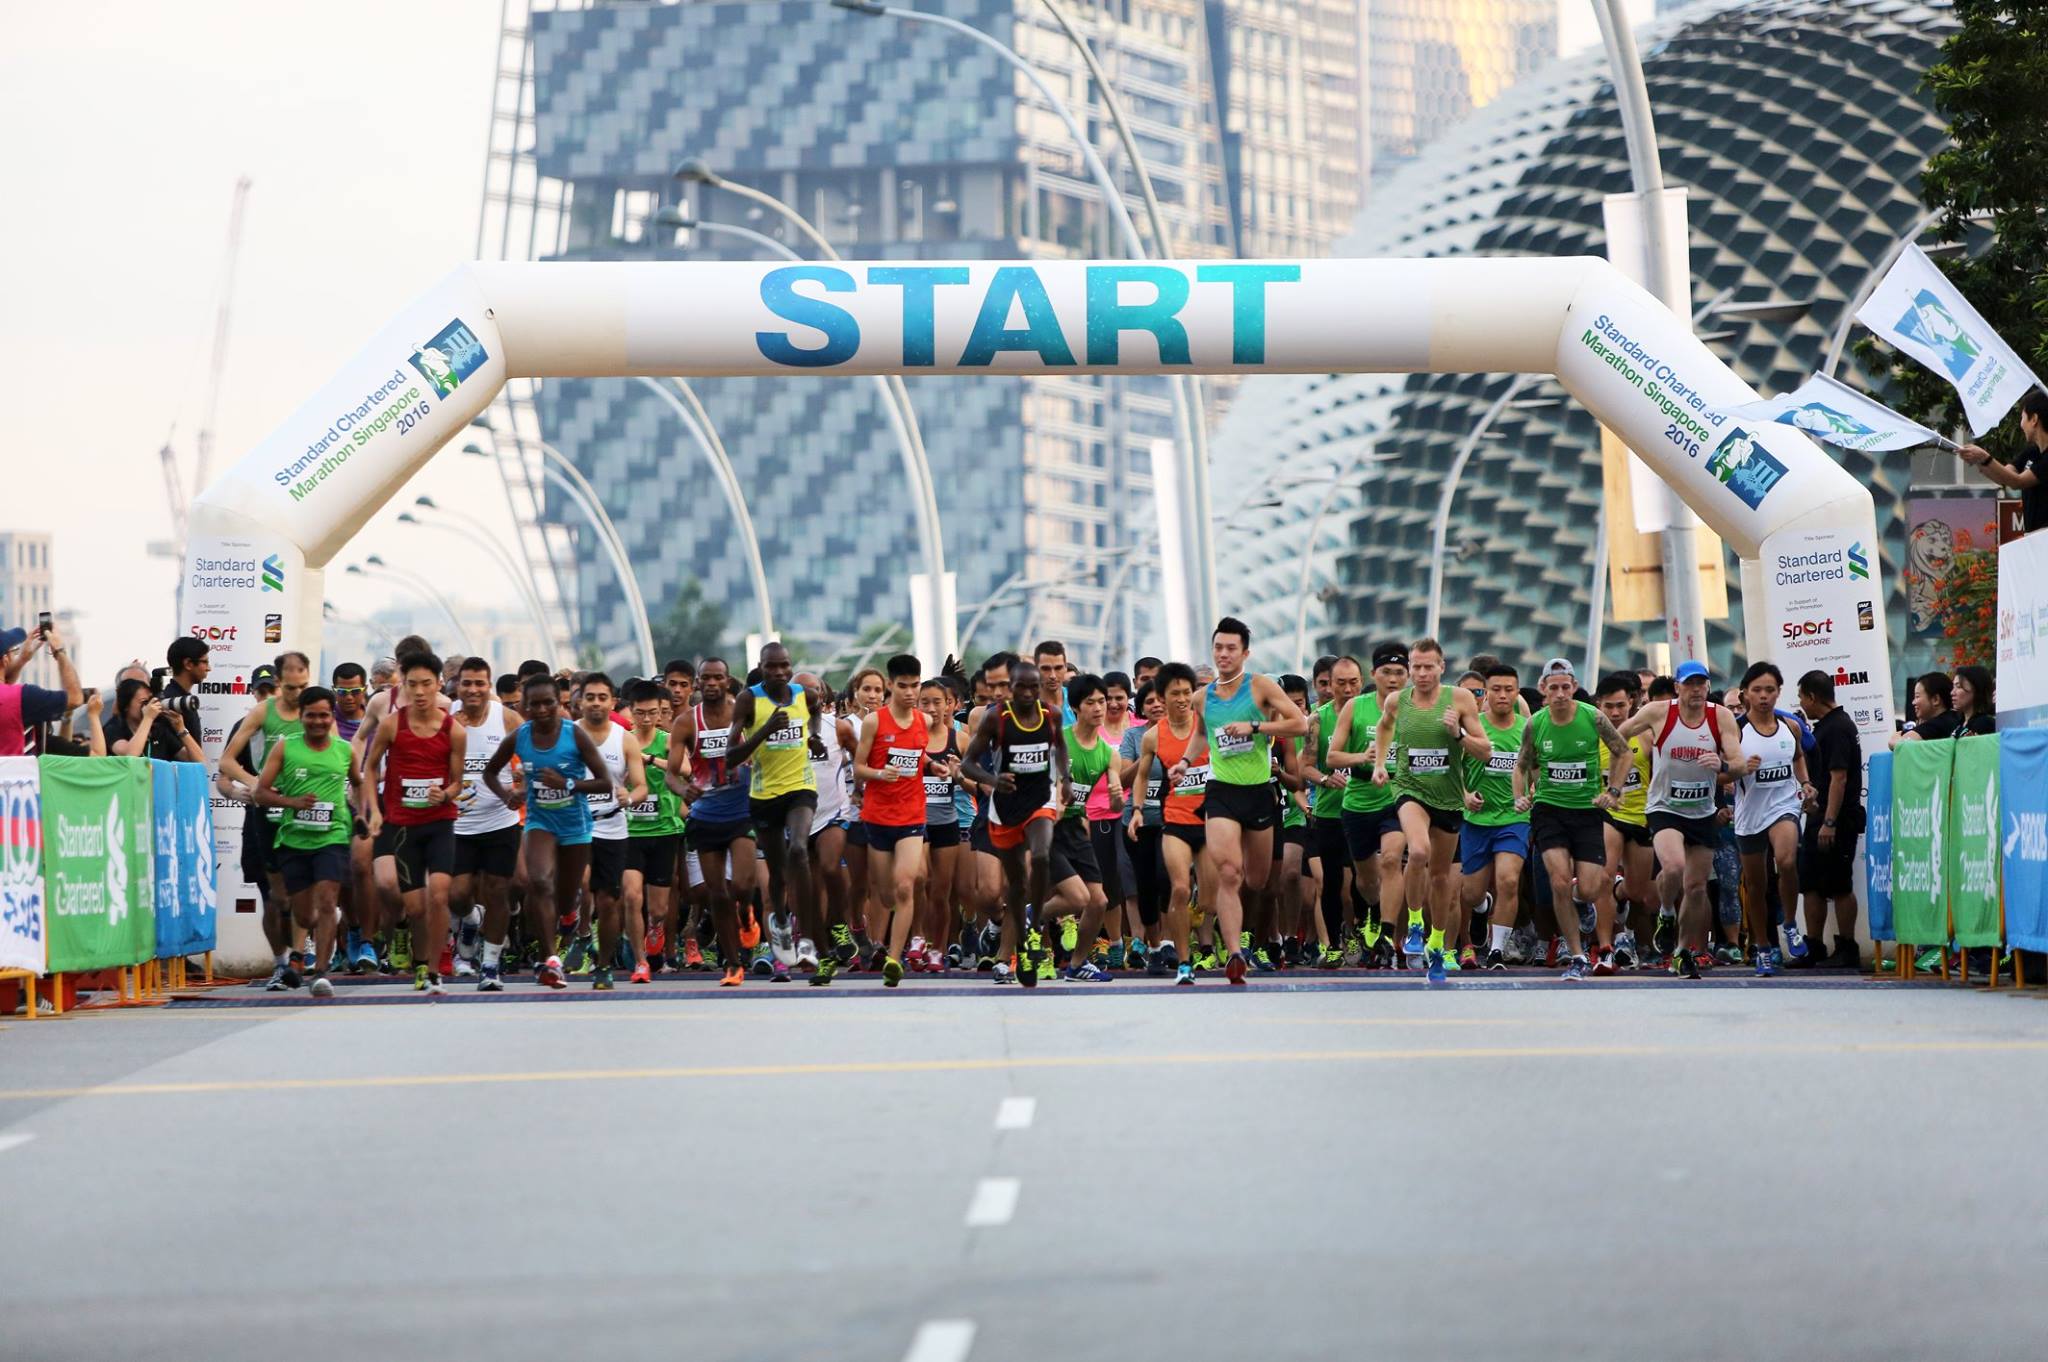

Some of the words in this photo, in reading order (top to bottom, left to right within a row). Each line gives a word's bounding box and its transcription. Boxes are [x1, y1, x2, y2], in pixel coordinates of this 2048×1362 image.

[755, 264, 1301, 367] START
[1594, 315, 1660, 371] Standard
[1581, 329, 1644, 388] Marathon
[1643, 381, 1710, 442] Singapore
[396, 401, 430, 435] 2016
[274, 428, 340, 486] Standard
[336, 369, 407, 432] Chartered
[288, 443, 356, 502] Marathon
[352, 386, 420, 446] Singapore
[1664, 424, 1700, 458] 2016
[195, 558, 256, 572] Standard
[1778, 549, 1842, 569] Standard
[192, 574, 255, 588] Chartered
[1776, 566, 1844, 586] Chartered
[191, 626, 237, 641] Sport
[1782, 618, 1833, 640] Sport
[1786, 637, 1831, 649] SINGAPORE
[203, 728, 224, 736] Sport
[702, 736, 728, 749] 4579
[605, 753, 619, 761] VISA
[1013, 751, 1045, 764] 44211
[1412, 756, 1446, 767] 45067
[1551, 769, 1582, 779] 40971
[1759, 766, 1789, 780] 57770
[1674, 788, 1705, 799] 47711
[297, 809, 331, 822] 46168
[1897, 797, 1930, 838] Standard
[58, 814, 104, 859] Standard
[55, 871, 105, 916] Chartered
